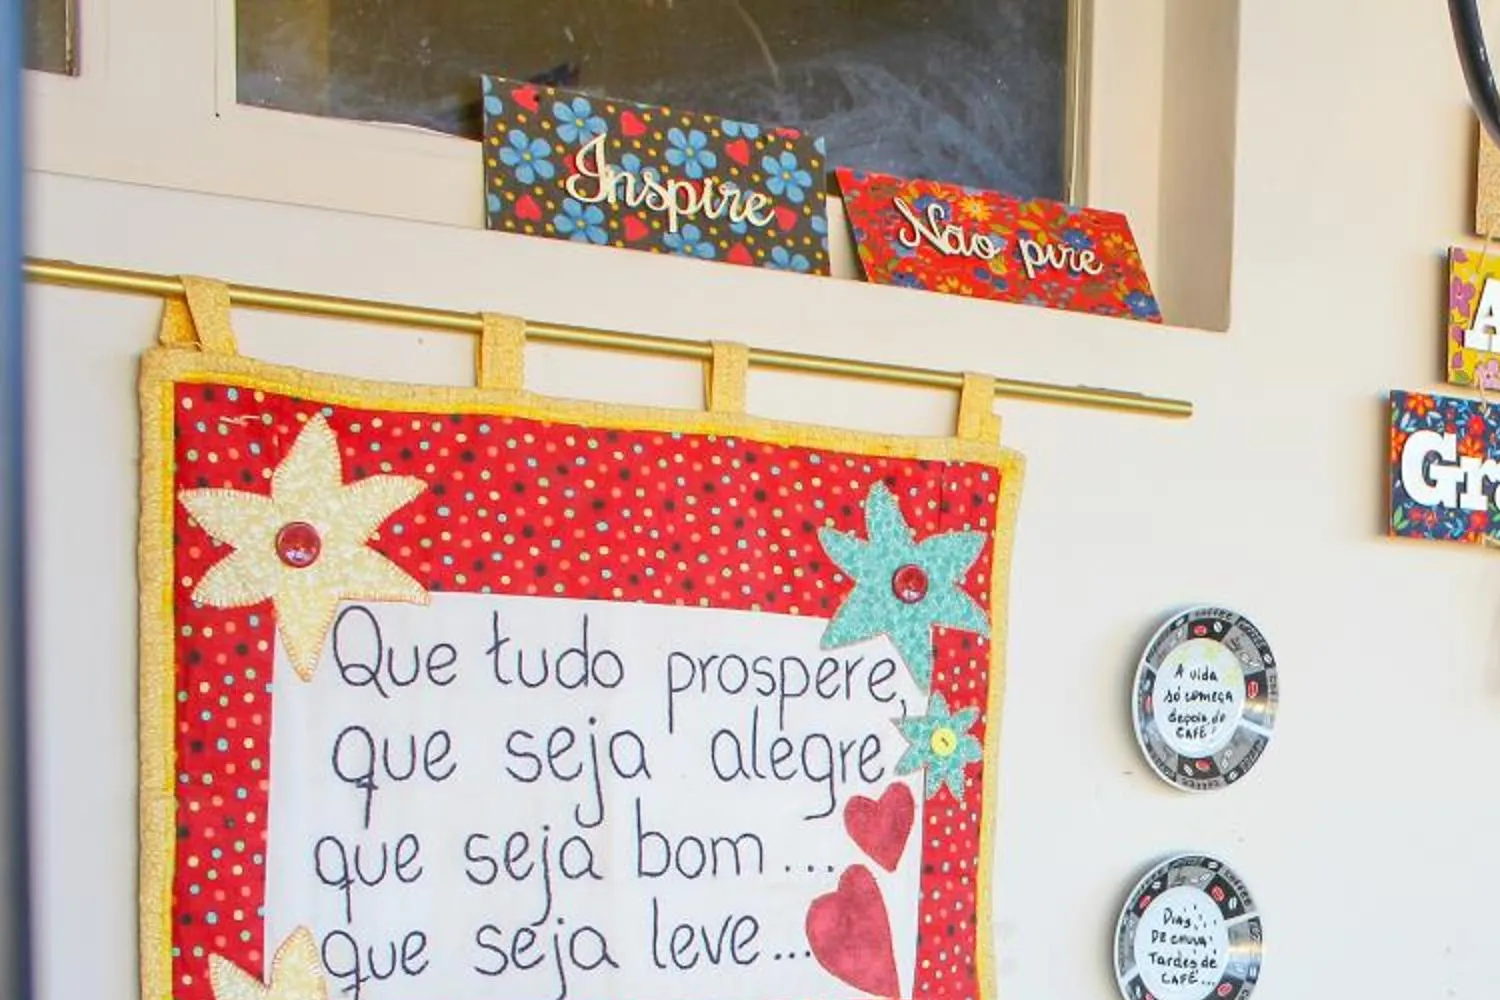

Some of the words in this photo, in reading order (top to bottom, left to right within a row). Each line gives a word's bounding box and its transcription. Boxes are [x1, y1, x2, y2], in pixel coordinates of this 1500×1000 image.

[566, 133, 774, 233] Inspire
[892, 197, 1000, 261] Não
[1019, 228, 1103, 278] pire
[332, 604, 458, 698] Que
[485, 610, 625, 688] tudo
[667, 650, 907, 733] prospere,
[1174, 663, 1185, 679] A
[1190, 664, 1218, 682] vida
[331, 725, 458, 829] que
[505, 717, 652, 828] seja
[710, 705, 886, 821] alegre
[314, 832, 424, 923] que
[464, 824, 604, 926] seja
